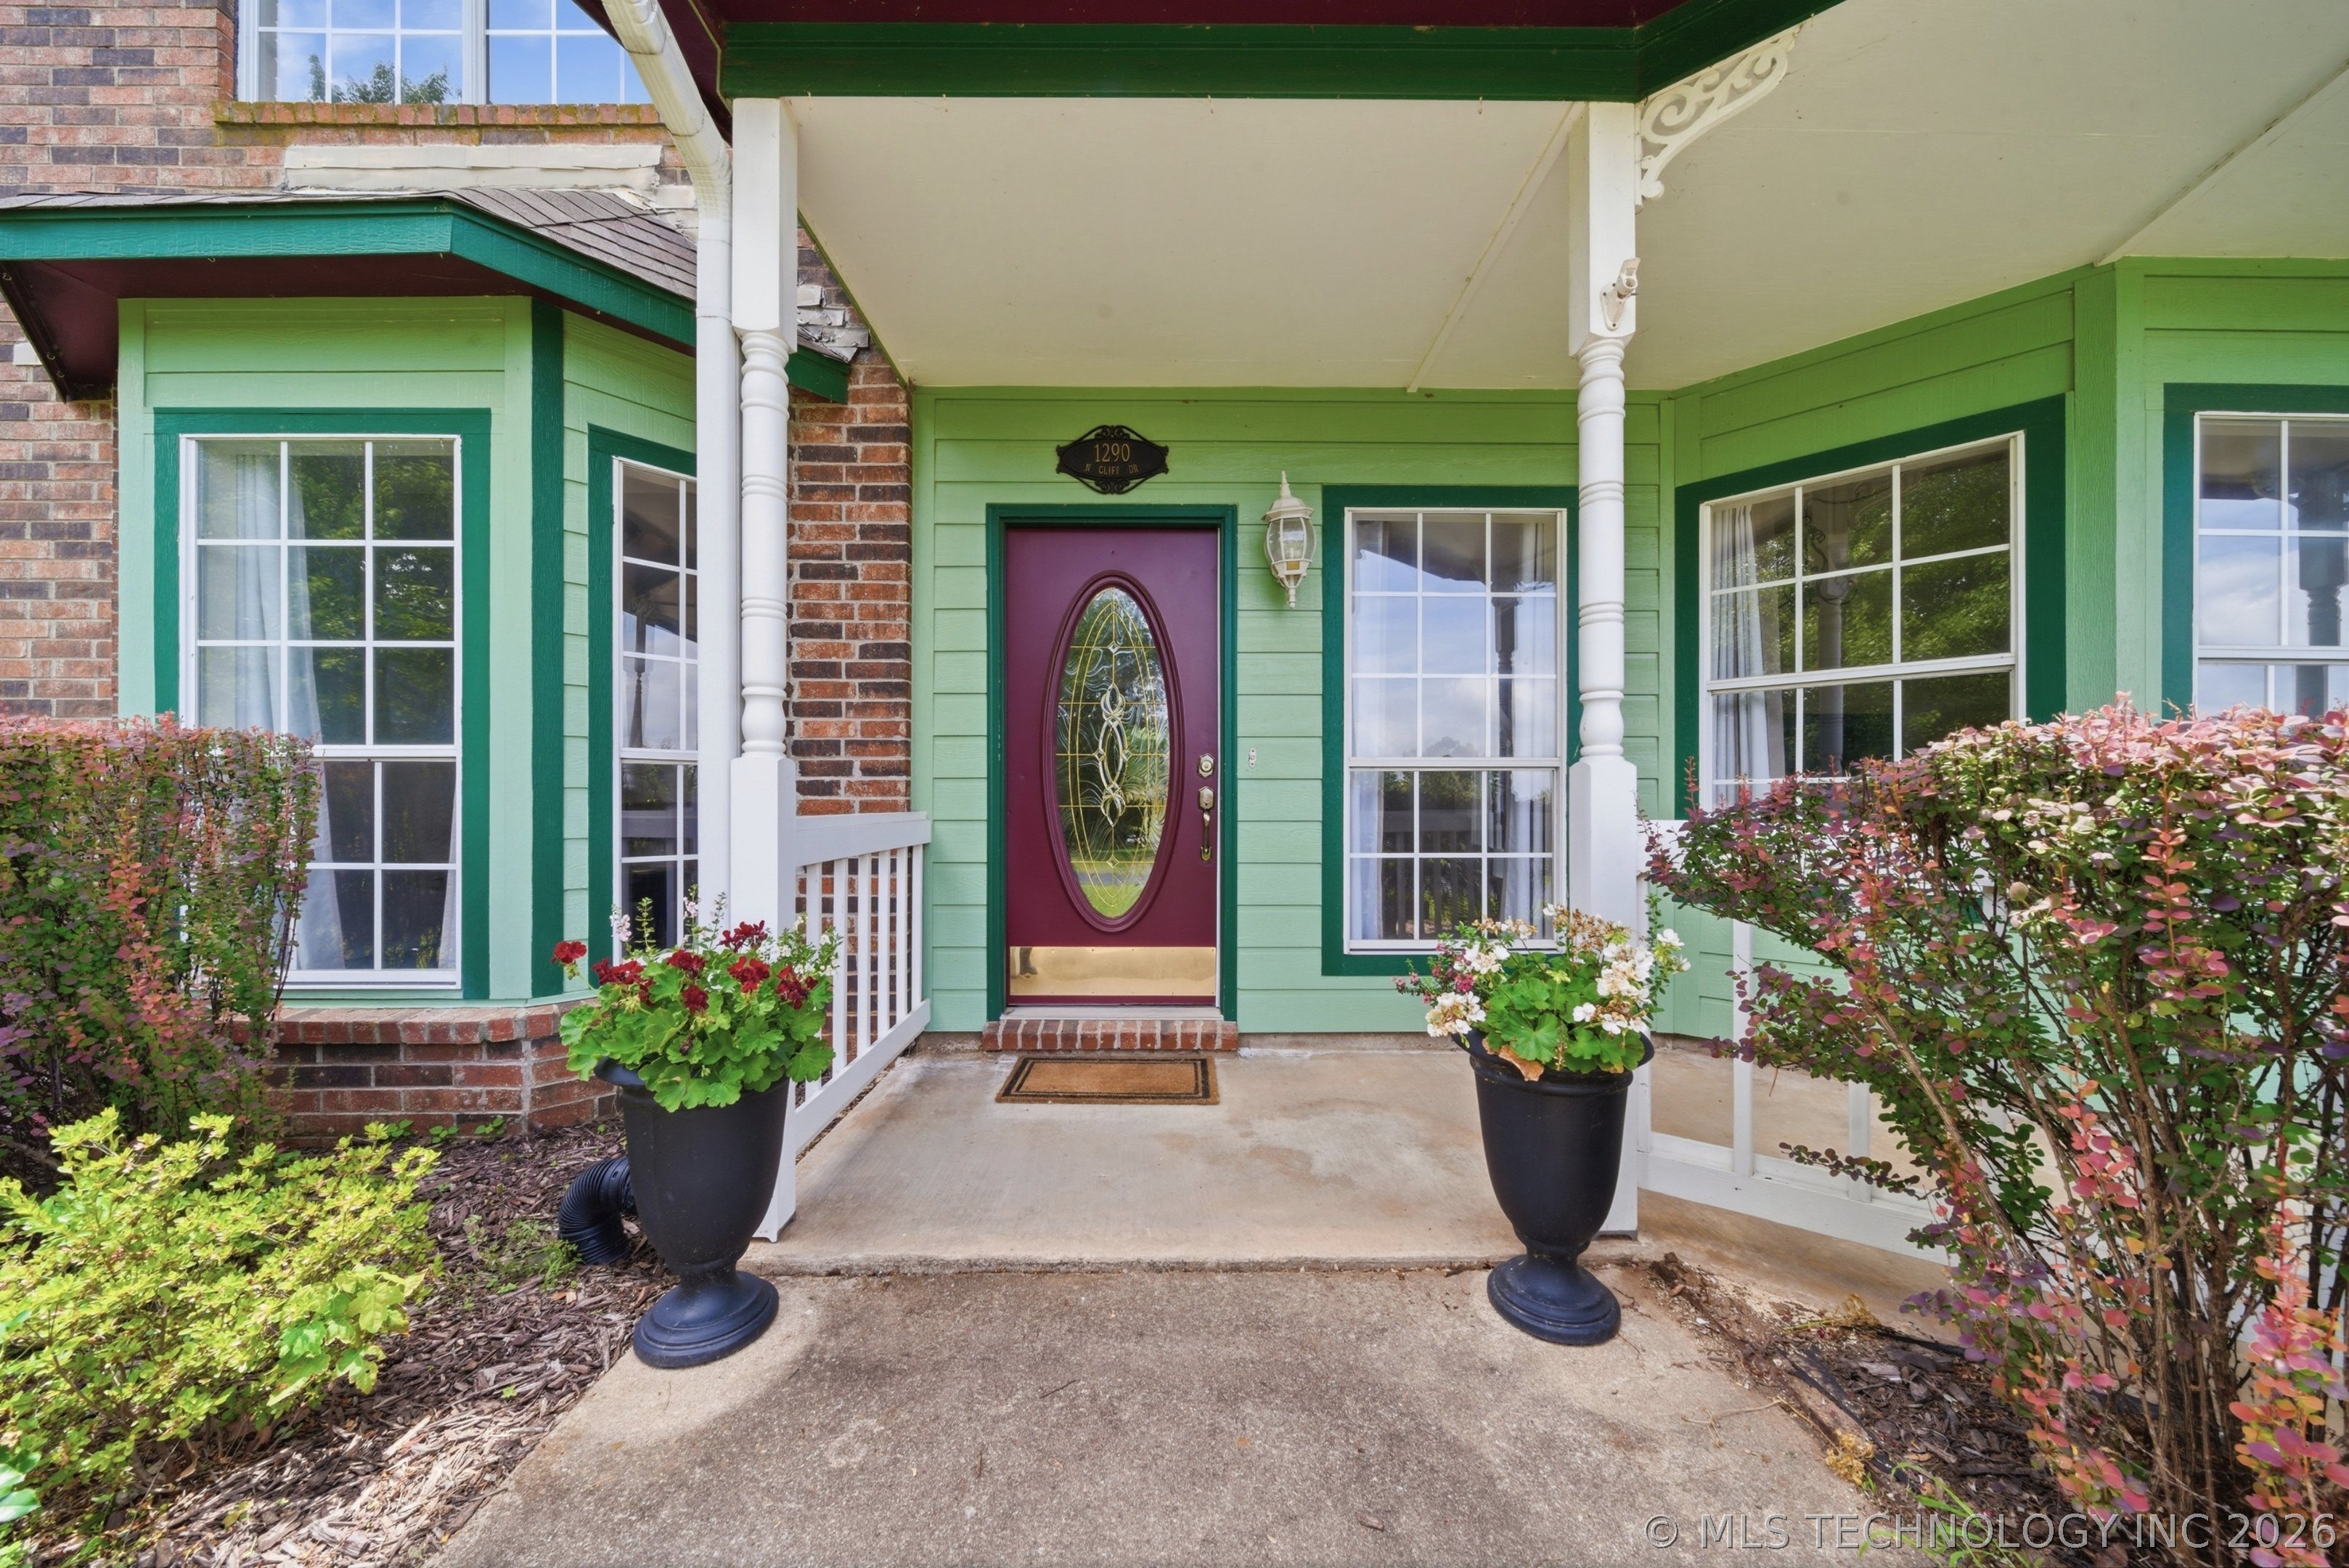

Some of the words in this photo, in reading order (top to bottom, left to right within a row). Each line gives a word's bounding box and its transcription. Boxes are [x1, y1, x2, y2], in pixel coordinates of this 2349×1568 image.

[1095, 444, 1130, 462] 1290
[1085, 463, 1092, 472] N
[1098, 465, 1119, 475] CLIFF
[1128, 464, 1139, 473] DR
